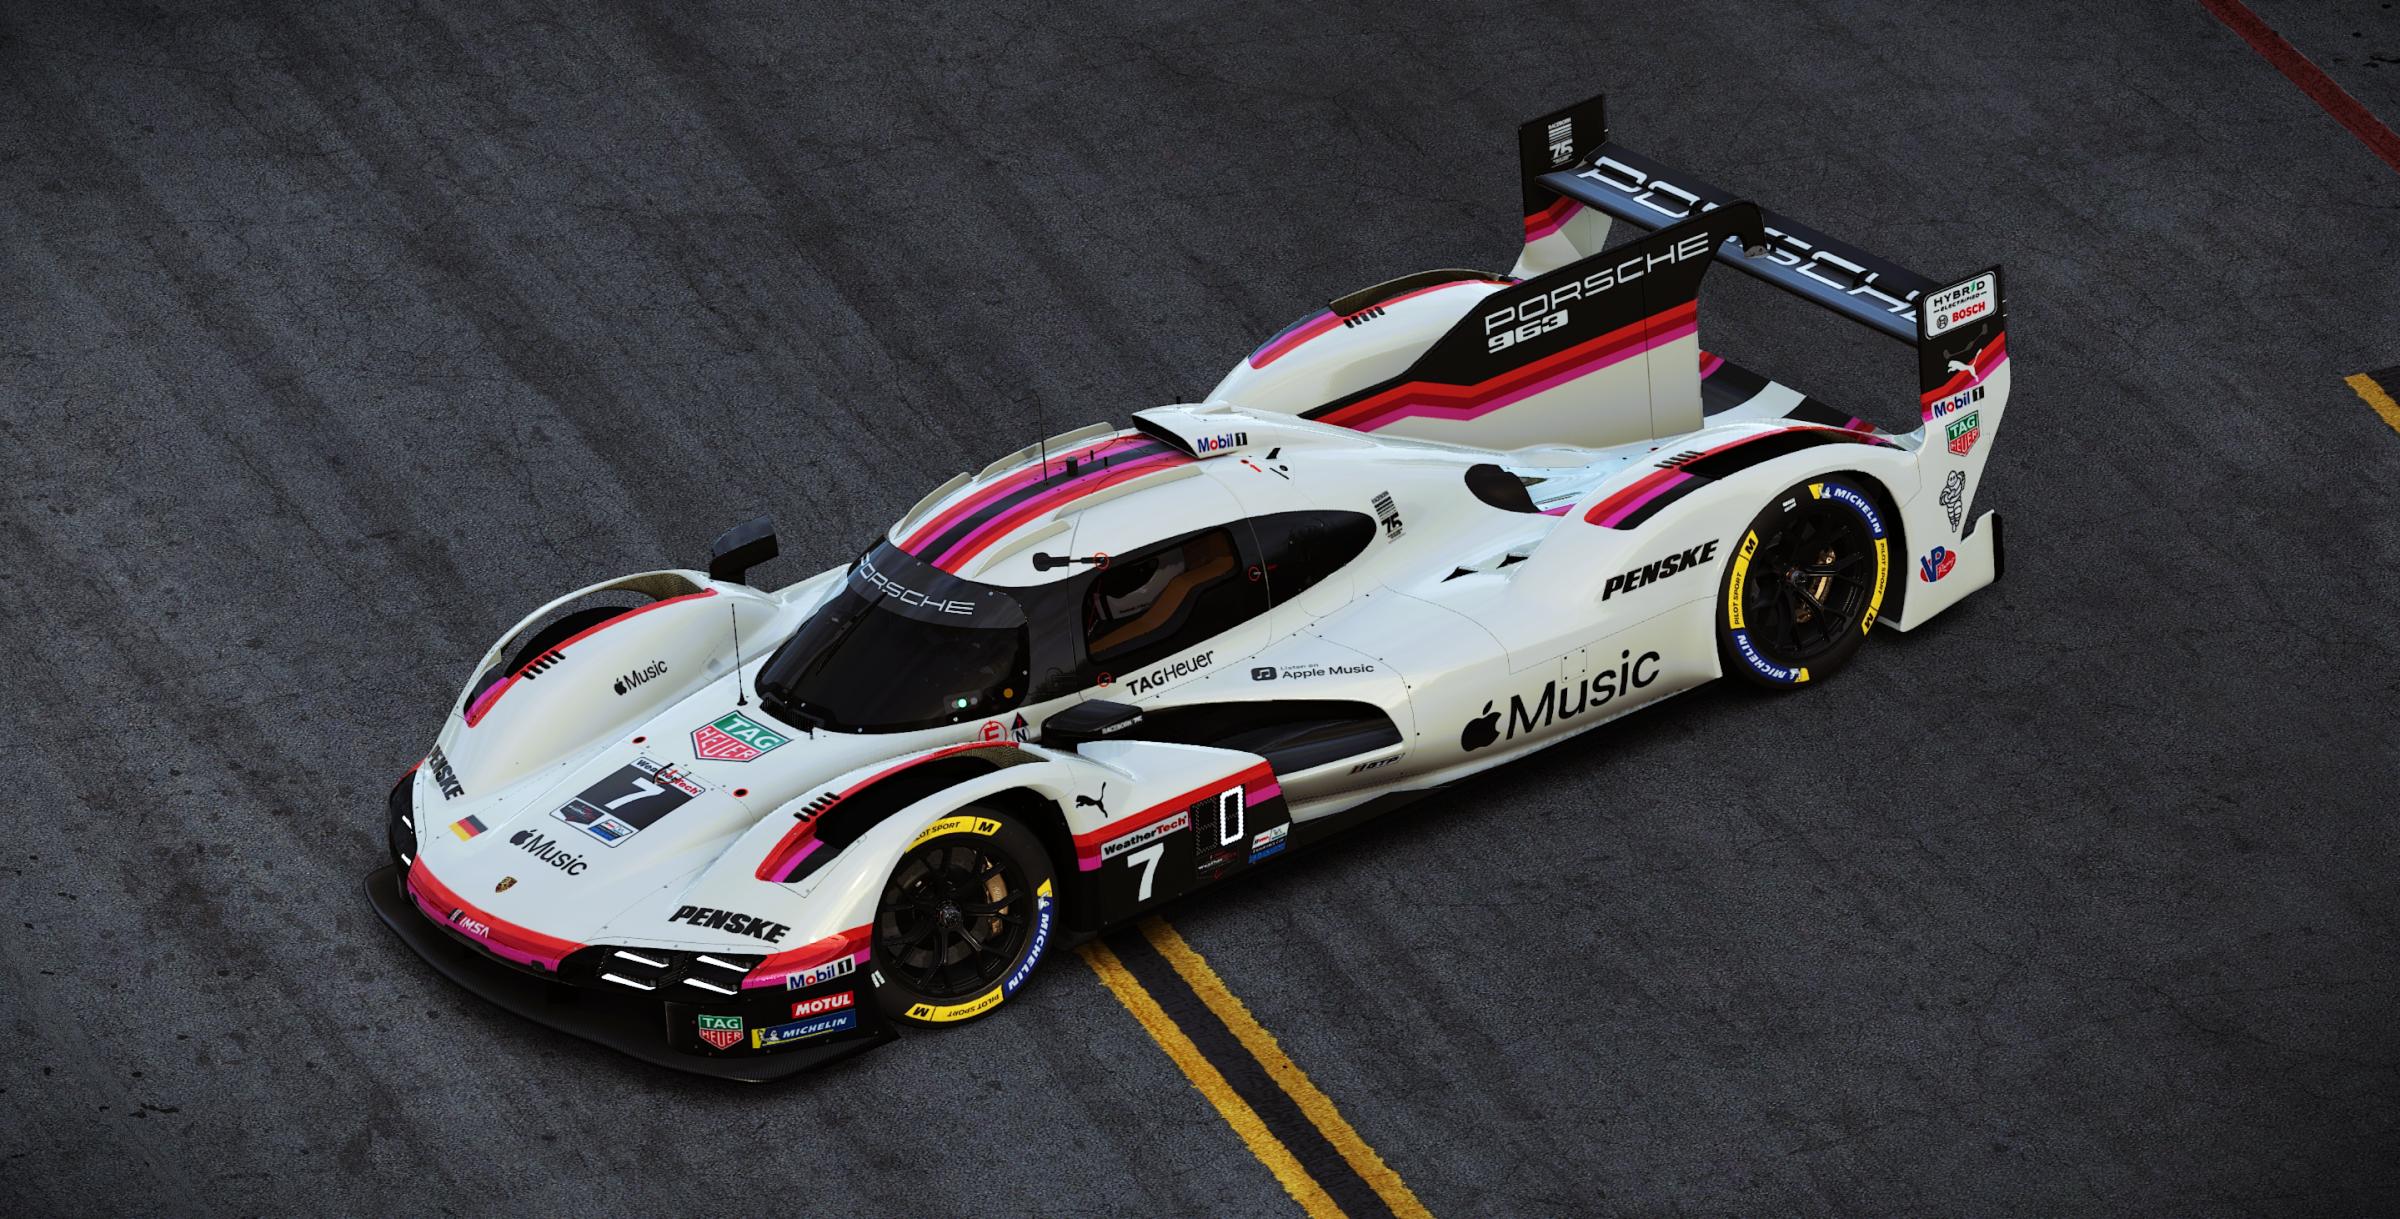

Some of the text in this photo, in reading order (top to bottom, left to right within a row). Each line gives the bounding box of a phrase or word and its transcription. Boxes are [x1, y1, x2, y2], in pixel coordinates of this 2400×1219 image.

[1549, 138, 1574, 158] 75
[1485, 232, 1709, 335] PORSCHE
[1933, 281, 1985, 307] HYBRID
[1952, 301, 1985, 322] BOSCH
[1488, 309, 1568, 354] 963
[1933, 391, 1970, 418] Mobil
[1950, 416, 1976, 437] TAG
[1198, 433, 1233, 453] Mobil
[1950, 430, 1979, 452] HEUER
[1381, 511, 1402, 534] 75
[1834, 488, 1882, 534] MICHELIN
[1602, 539, 1719, 602] PENSKE
[1733, 571, 1742, 601] SPORT
[1745, 538, 1757, 555] M
[1920, 546, 1945, 582] VP
[1878, 567, 1887, 594] SPORT
[1737, 634, 1787, 680] MICHELIN
[625, 658, 668, 692] Music
[1282, 664, 1375, 680] Apple Music
[1506, 649, 1660, 741] Music
[699, 726, 756, 760] HEUER
[724, 717, 779, 750] TAG
[605, 777, 666, 810] 7
[931, 821, 961, 833] SPORT
[978, 821, 995, 832] M
[1104, 816, 1187, 856] WeatherTech
[525, 833, 588, 876] Music
[1127, 842, 1165, 902] 7
[459, 916, 490, 939] IMSA
[668, 904, 791, 943] PENSKE
[1007, 913, 1050, 991] MICHELIN
[790, 965, 836, 989] Mobil
[795, 993, 851, 1016] MOTUL
[913, 994, 1000, 1017] PILOT SPORT M
[702, 1017, 739, 1029] TAG
[783, 1016, 848, 1039] MICHELIN
[701, 1030, 742, 1050] HEUER
